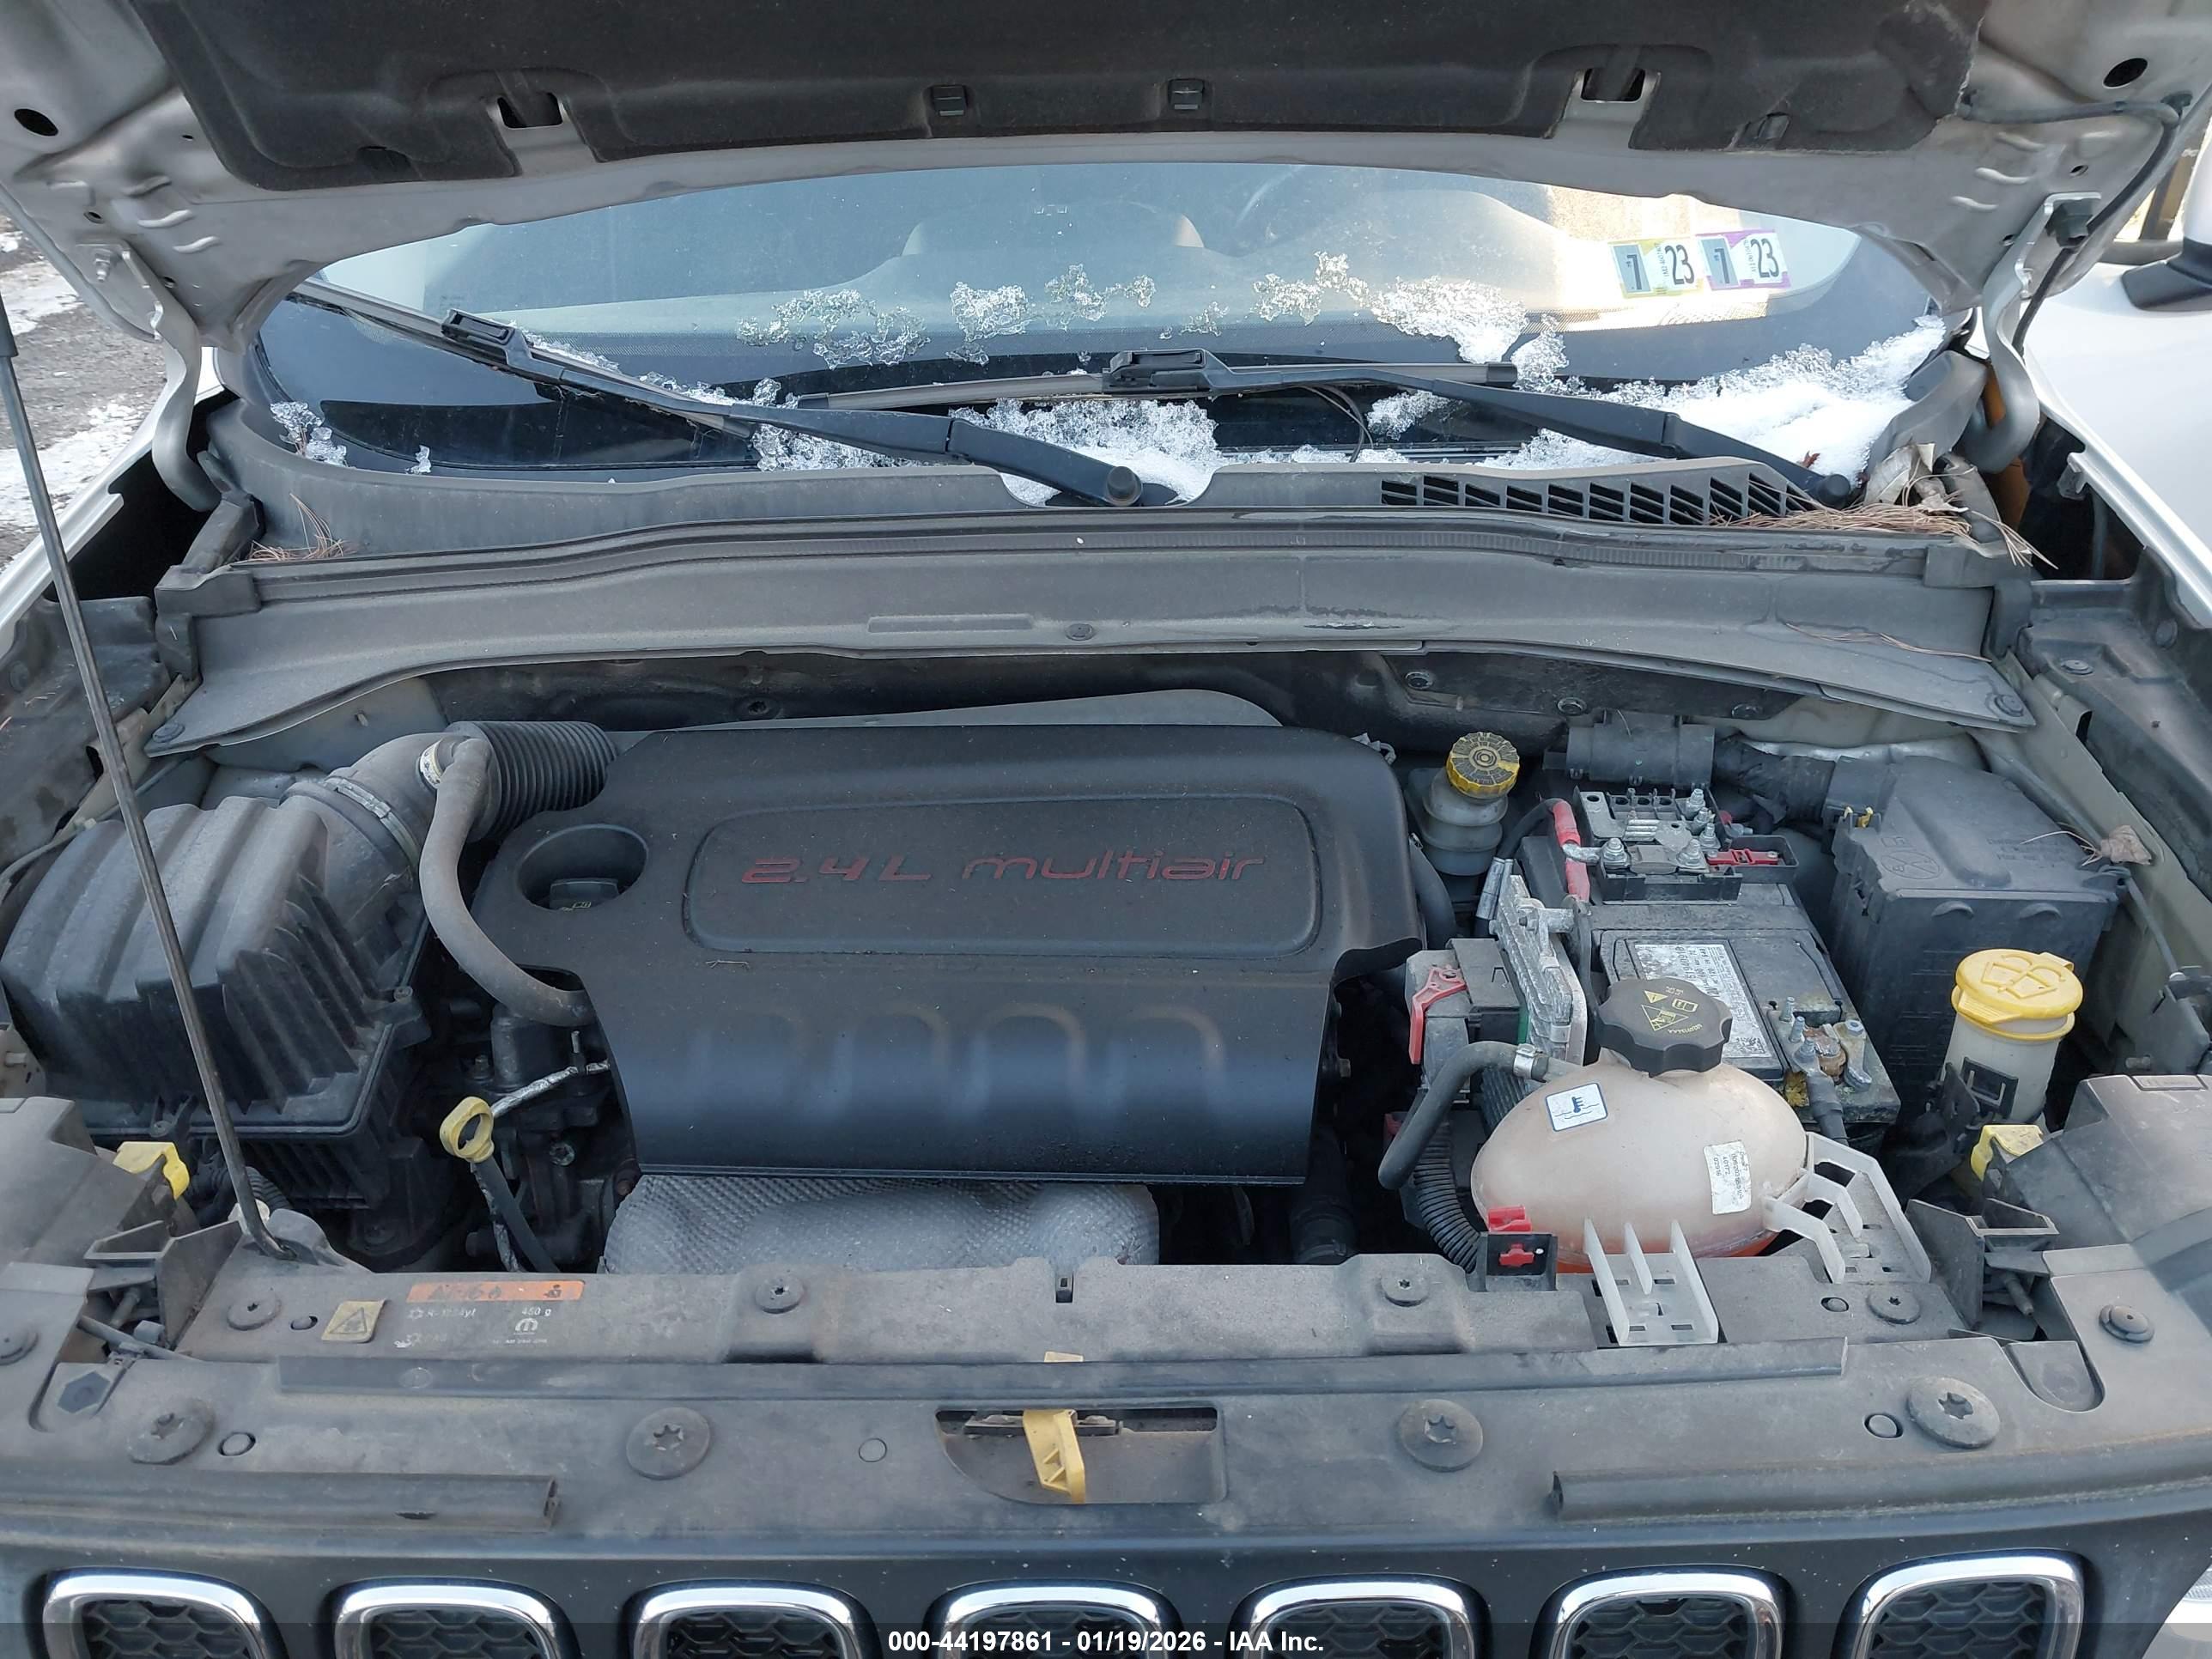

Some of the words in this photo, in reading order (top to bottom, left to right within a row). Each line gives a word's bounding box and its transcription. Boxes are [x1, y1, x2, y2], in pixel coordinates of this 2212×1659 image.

[1664, 243, 1696, 286] 23
[1749, 237, 1780, 278] 23
[961, 848, 1266, 881] multiair
